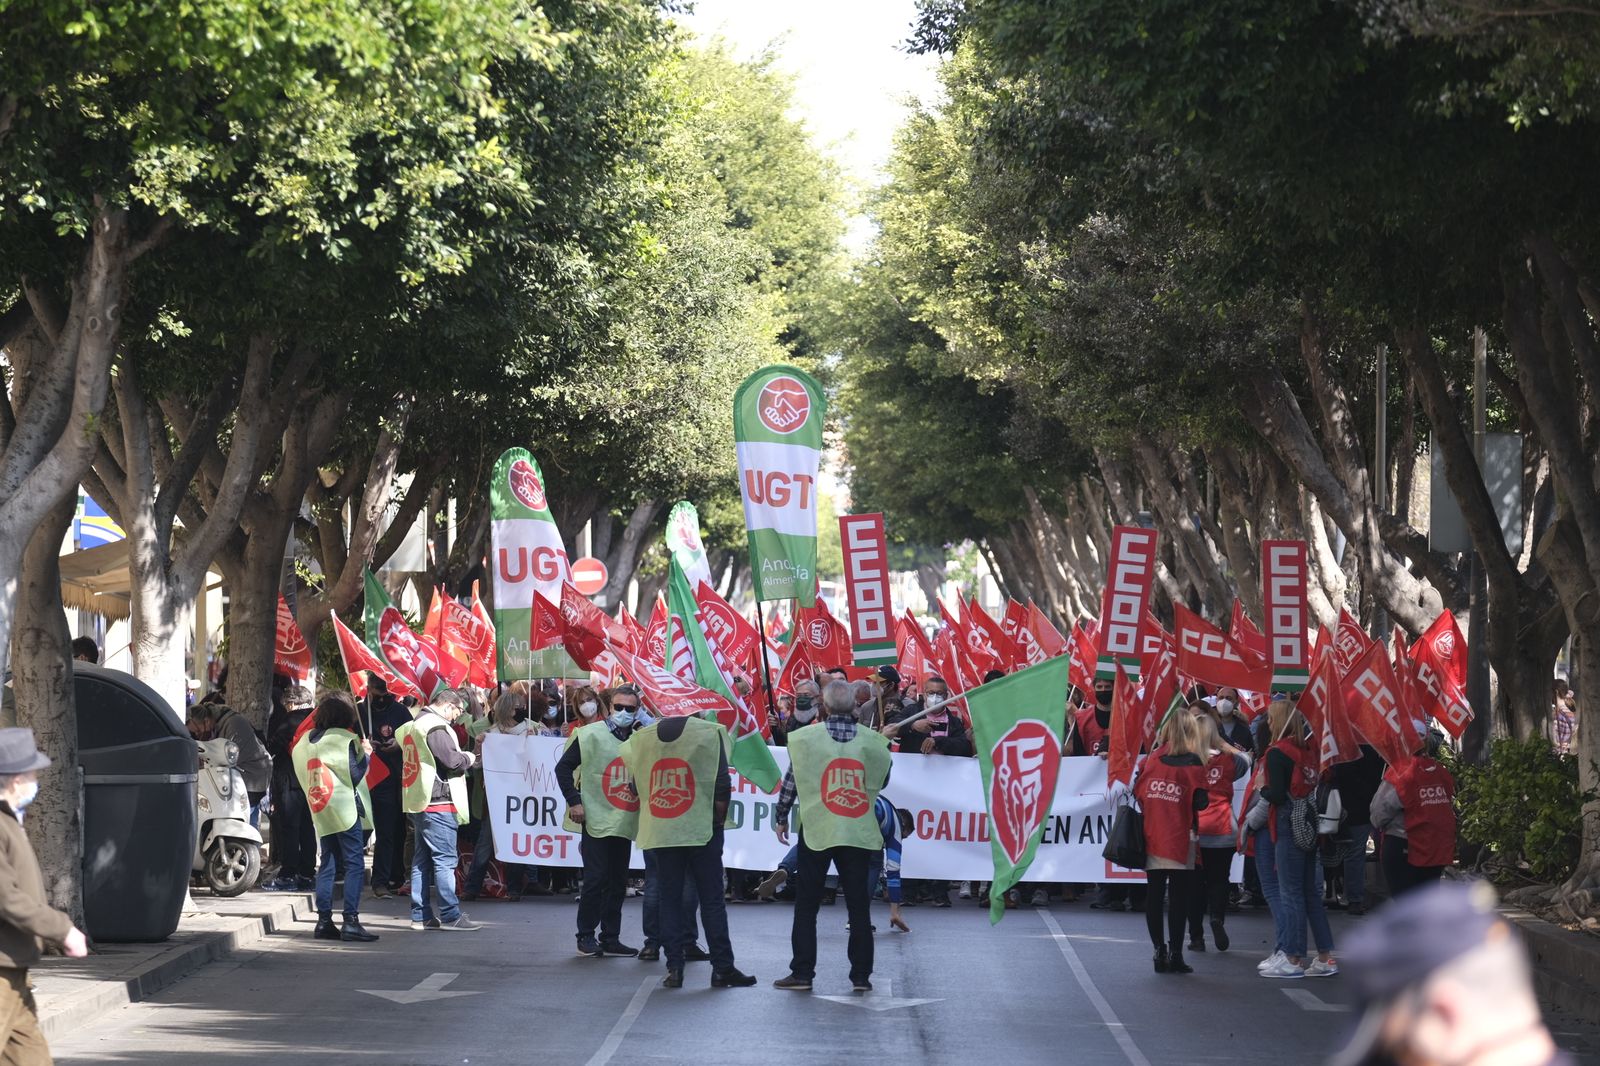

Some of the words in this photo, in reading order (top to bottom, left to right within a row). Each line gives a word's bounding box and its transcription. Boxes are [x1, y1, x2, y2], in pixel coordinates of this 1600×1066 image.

[745, 469, 814, 510] UGT
[500, 547, 573, 583] UGT
[847, 519, 888, 640] CCOO
[1106, 532, 1150, 654] CCOO
[1270, 546, 1302, 665] CCOO
[1417, 661, 1469, 727] CCOO
[652, 767, 690, 792] UGT
[827, 768, 865, 792] UGT
[506, 795, 558, 827] POR
[916, 809, 992, 842] CALID
[1078, 815, 1113, 844] AN
[512, 833, 573, 860] UGT
